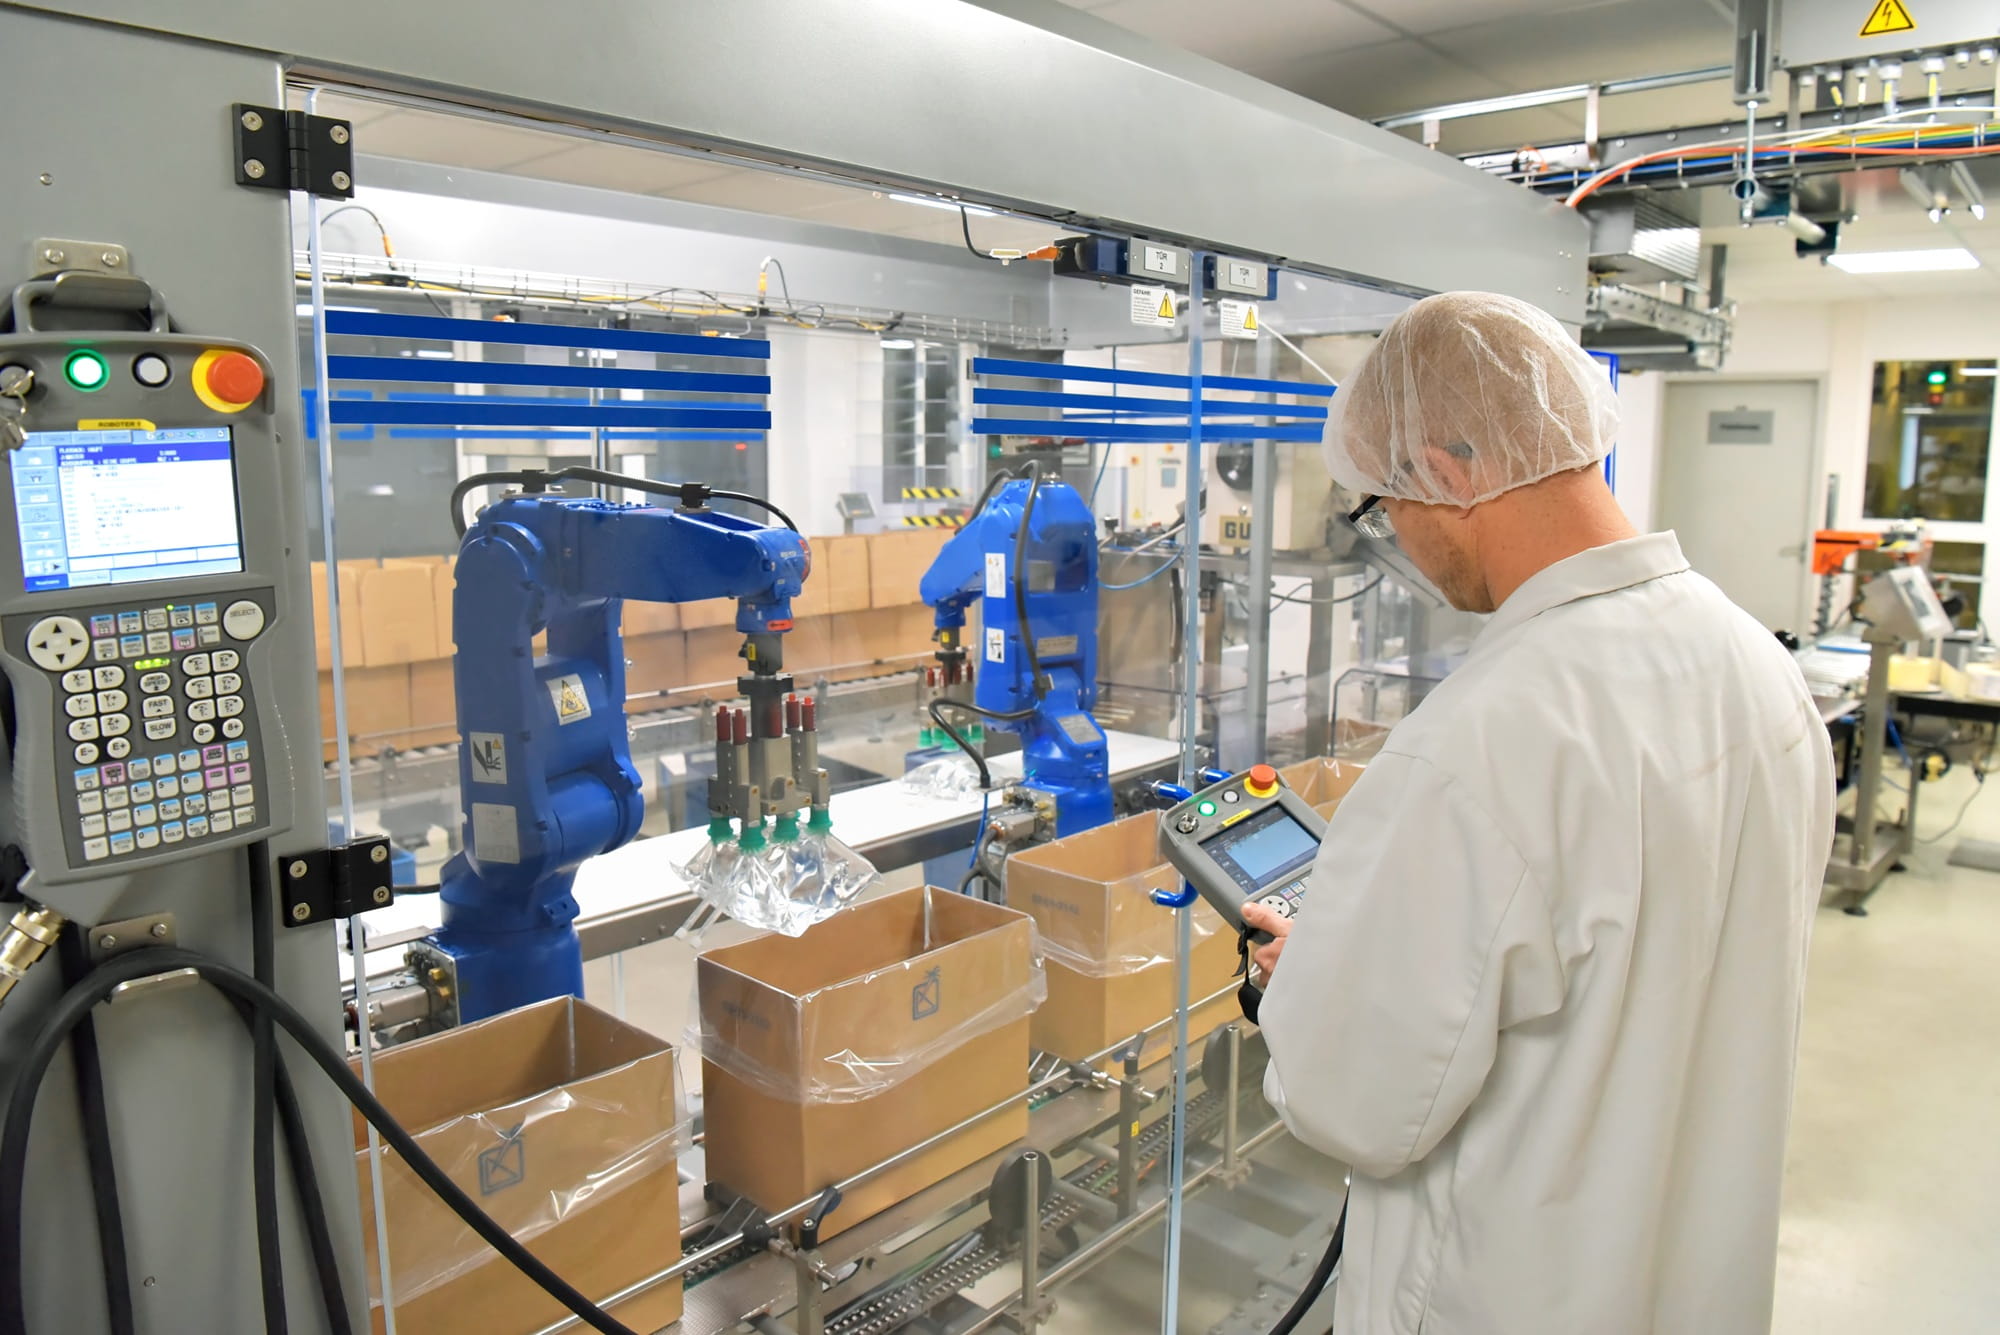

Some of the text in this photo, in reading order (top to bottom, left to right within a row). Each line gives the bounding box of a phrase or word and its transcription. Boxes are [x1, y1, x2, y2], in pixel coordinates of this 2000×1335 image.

[1156, 251, 1168, 260] TÜR
[1159, 262, 1164, 270] 2
[229, 608, 256, 618] SELECT
[148, 699, 167, 708] FAST
[149, 722, 171, 732] SLOW
[112, 742, 125, 751] E+
